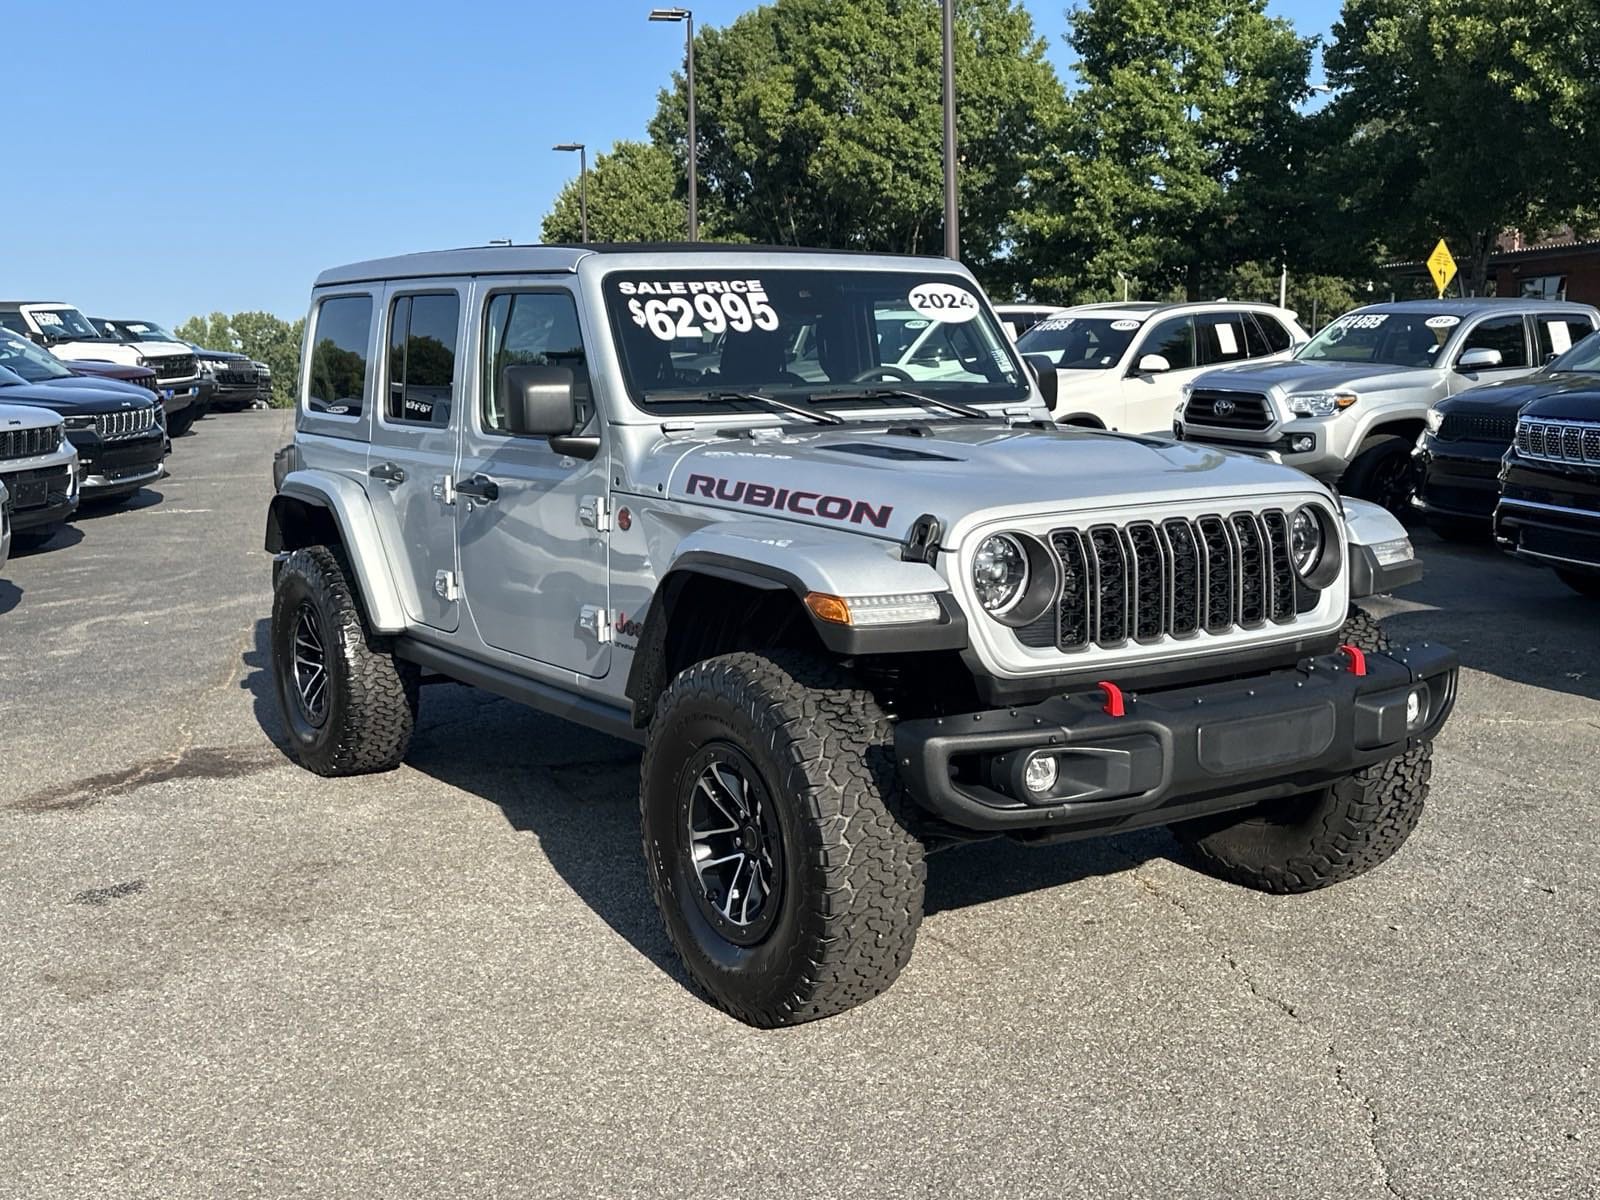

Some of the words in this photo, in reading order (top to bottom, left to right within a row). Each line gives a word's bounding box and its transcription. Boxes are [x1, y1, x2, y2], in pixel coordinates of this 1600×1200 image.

[618, 281, 688, 295] SALE
[688, 280, 764, 294] PRICE
[913, 292, 974, 309] 2024
[627, 292, 780, 341] $62995
[686, 473, 894, 529] RUBICON
